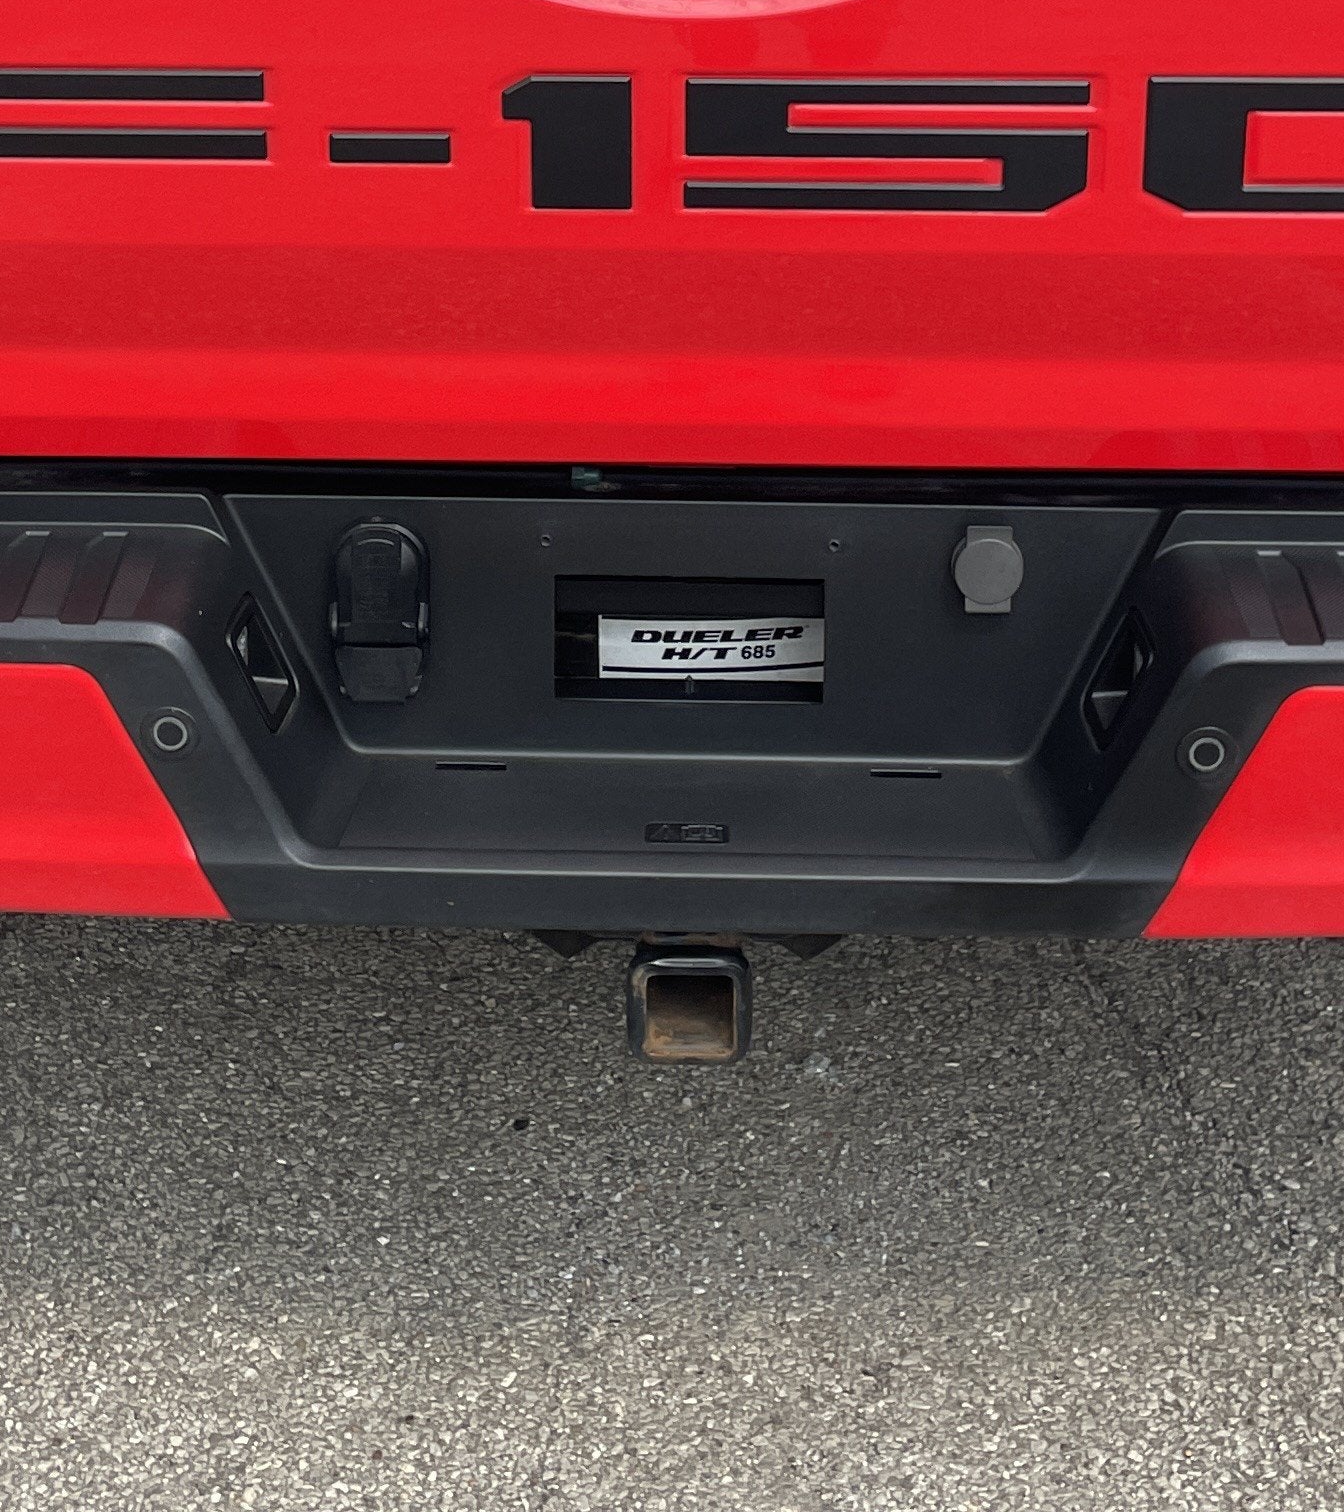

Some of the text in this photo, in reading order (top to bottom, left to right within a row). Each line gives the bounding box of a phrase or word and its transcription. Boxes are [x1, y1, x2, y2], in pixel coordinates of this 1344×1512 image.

[631, 626, 804, 643] DUELER
[661, 645, 776, 660] H/T 685
